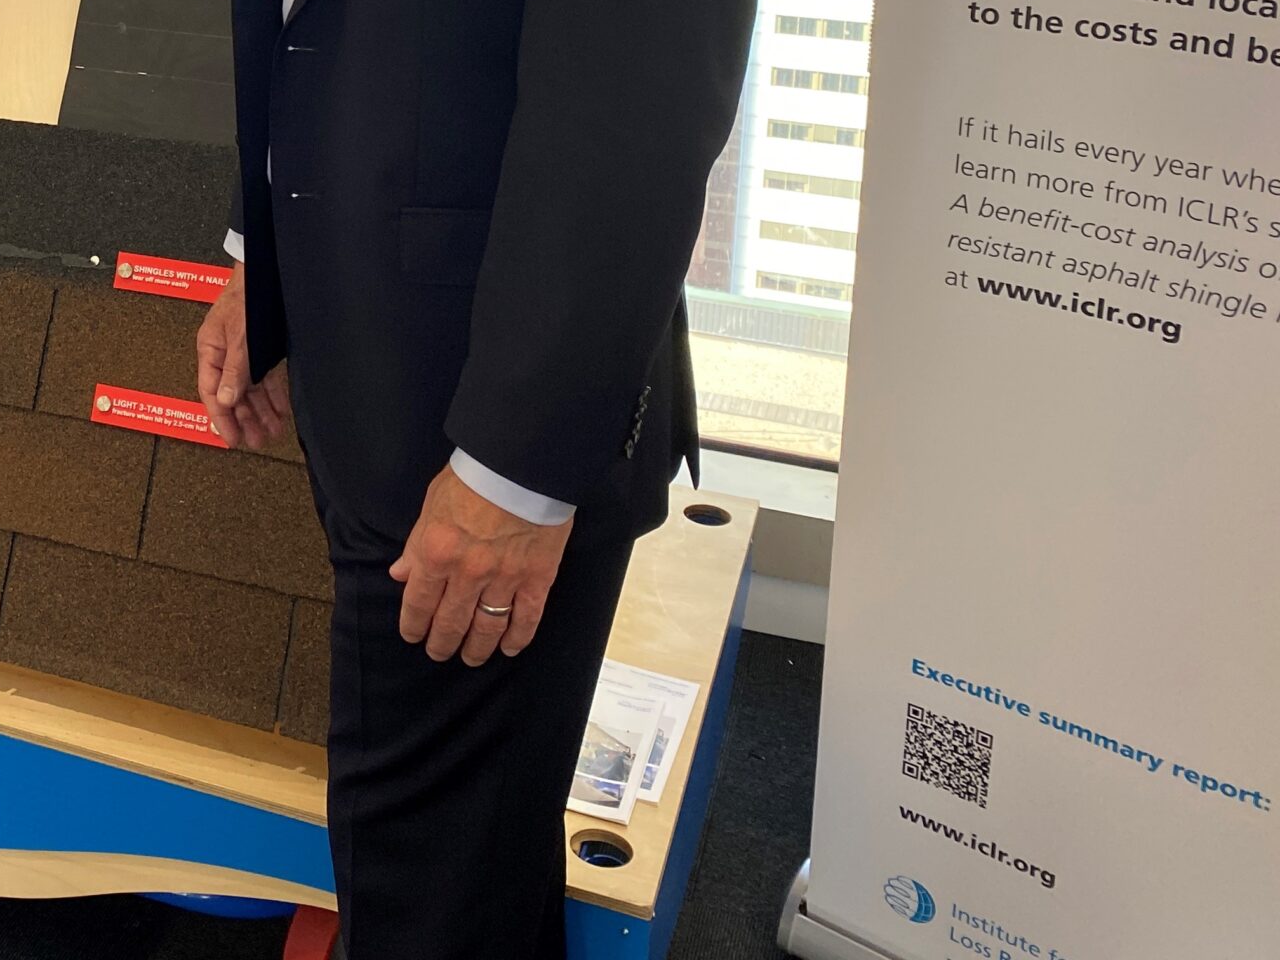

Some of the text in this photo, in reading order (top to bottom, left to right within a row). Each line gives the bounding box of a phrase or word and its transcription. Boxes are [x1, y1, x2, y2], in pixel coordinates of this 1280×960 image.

[957, 116, 1213, 181] If it hails every year
[949, 194, 1249, 274] A benefit-cost analysis
[134, 265, 174, 277] SHINGLES
[176, 271, 198, 281] WITH
[199, 274, 204, 282] 4
[171, 280, 189, 289] easily
[947, 232, 1268, 319] resistant asphalt shingle
[945, 270, 1183, 344] at www.iclr.org
[112, 408, 135, 418] fracture
[137, 413, 153, 421] when
[113, 399, 208, 423] LIGHT 3-TAB SHINGLES
[911, 658, 1272, 812] Executive summary report:
[899, 805, 1057, 888] www.iclr.org
[949, 926, 992, 959] Loss
[951, 903, 1041, 958] Institute
